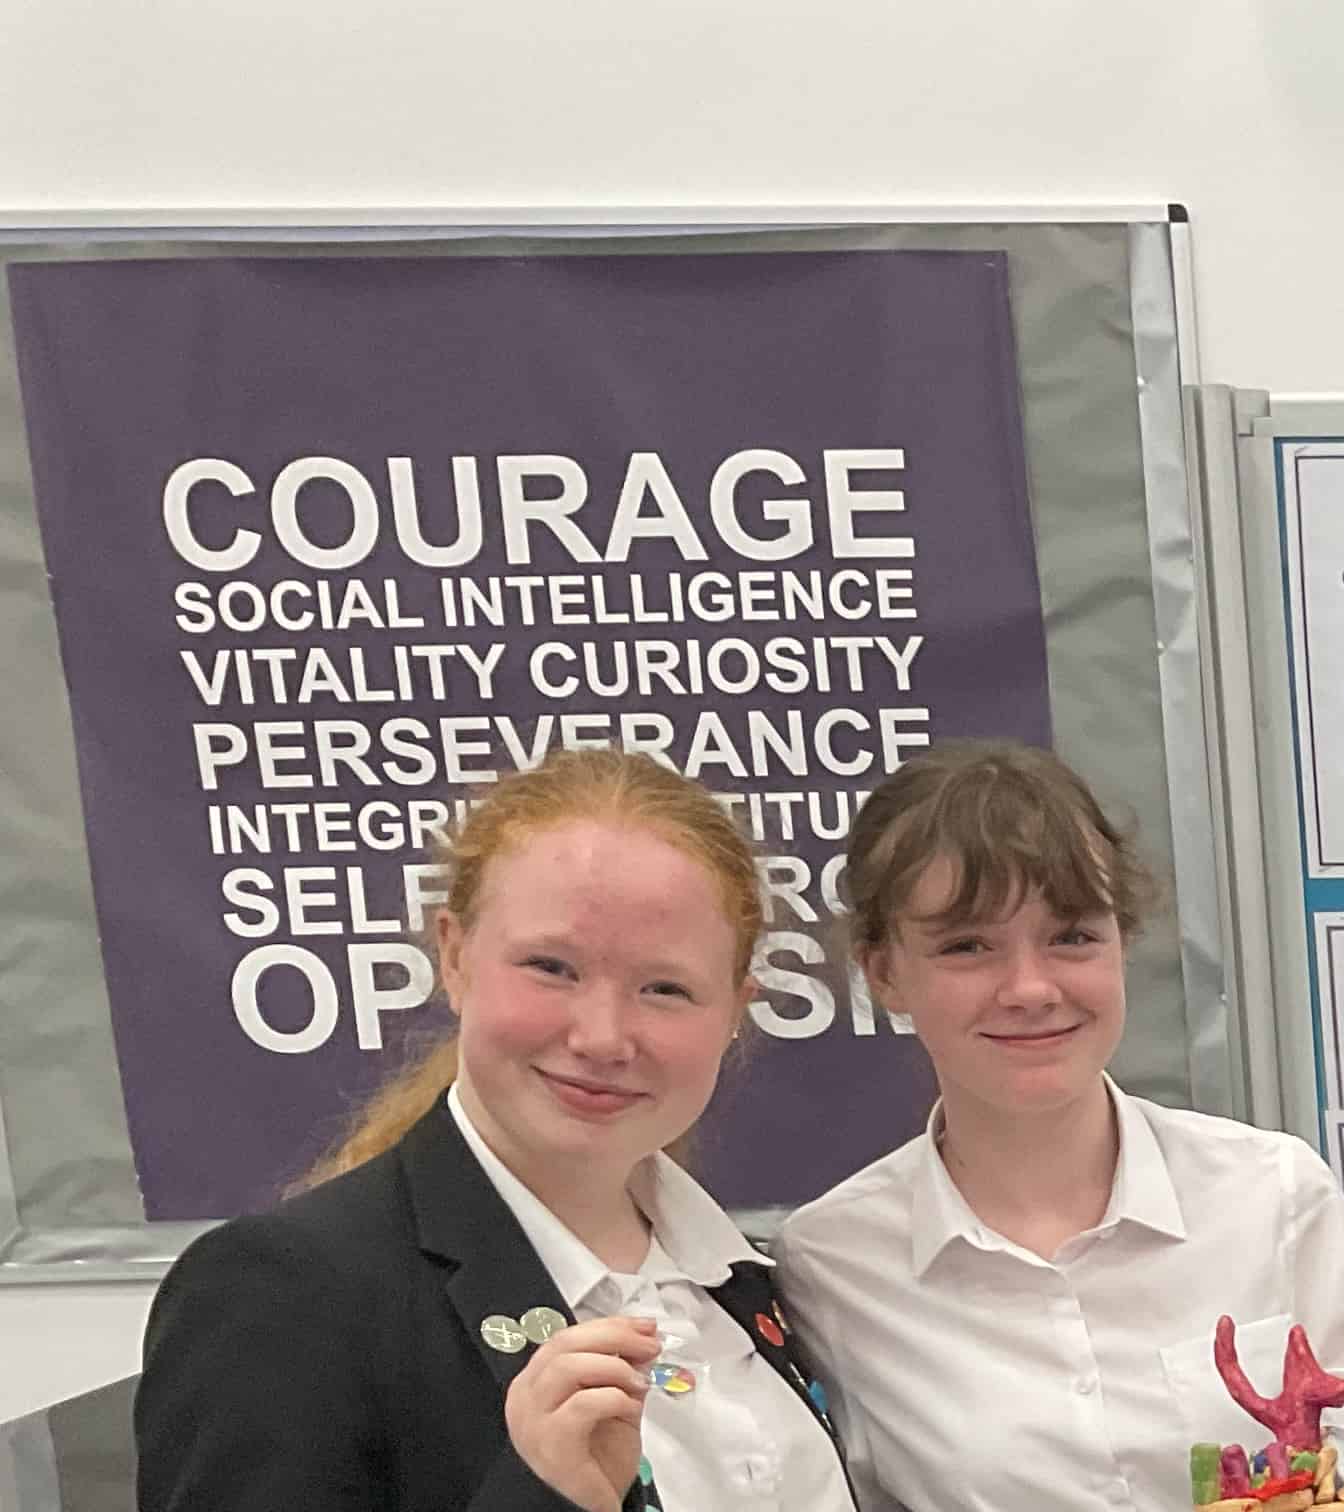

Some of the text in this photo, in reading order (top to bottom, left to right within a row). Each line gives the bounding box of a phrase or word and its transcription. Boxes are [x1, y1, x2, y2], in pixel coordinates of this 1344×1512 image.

[163, 448, 915, 571] COURAGE
[175, 570, 917, 634] SOCIAL INTELLIGENCE
[181, 636, 924, 705] VITALITY CURIOSITY
[192, 707, 932, 790] PERSEVERANCE
[209, 800, 484, 854] INTEGRI
